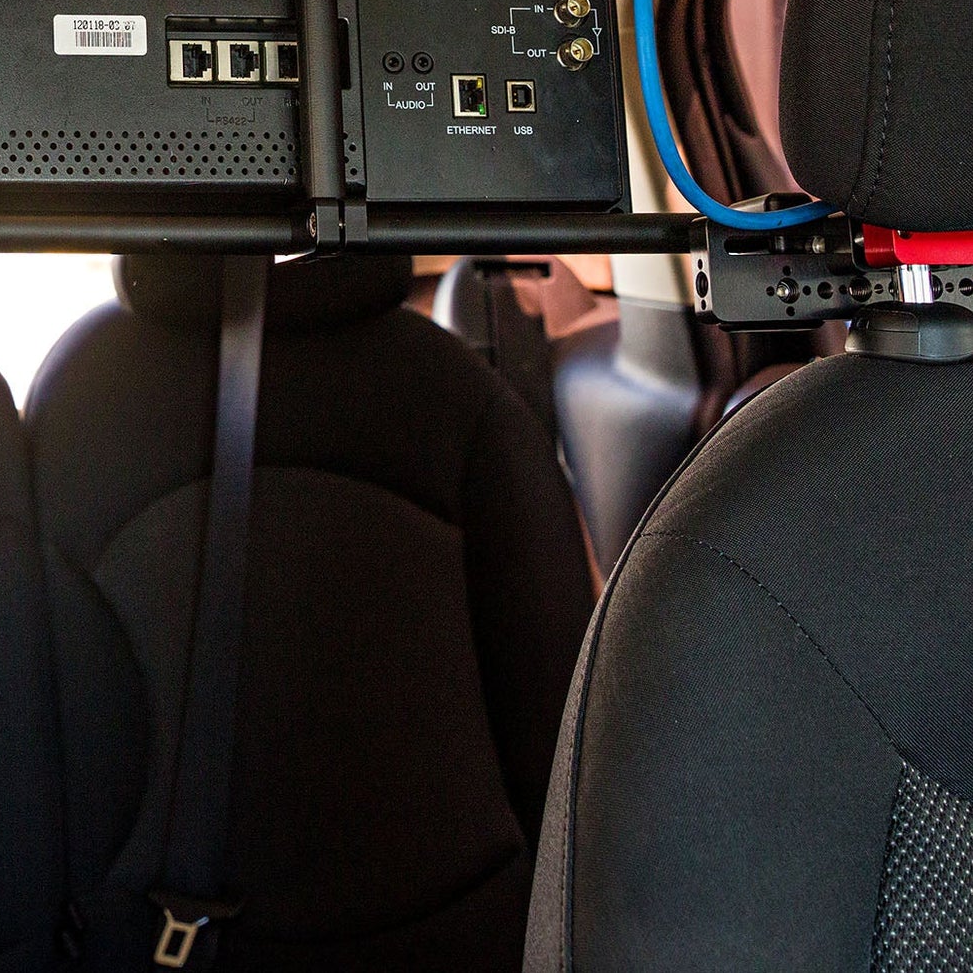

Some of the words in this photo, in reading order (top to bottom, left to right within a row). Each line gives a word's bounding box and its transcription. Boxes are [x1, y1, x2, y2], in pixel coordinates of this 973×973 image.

[534, 5, 544, 13] IN
[491, 26, 516, 34] SDI-B
[527, 49, 547, 57] OUT
[383, 82, 393, 90] IN
[416, 82, 435, 91] OUT
[395, 100, 425, 109] AUDIO
[447, 126, 496, 135] ETHERNET
[514, 127, 533, 135] USB
